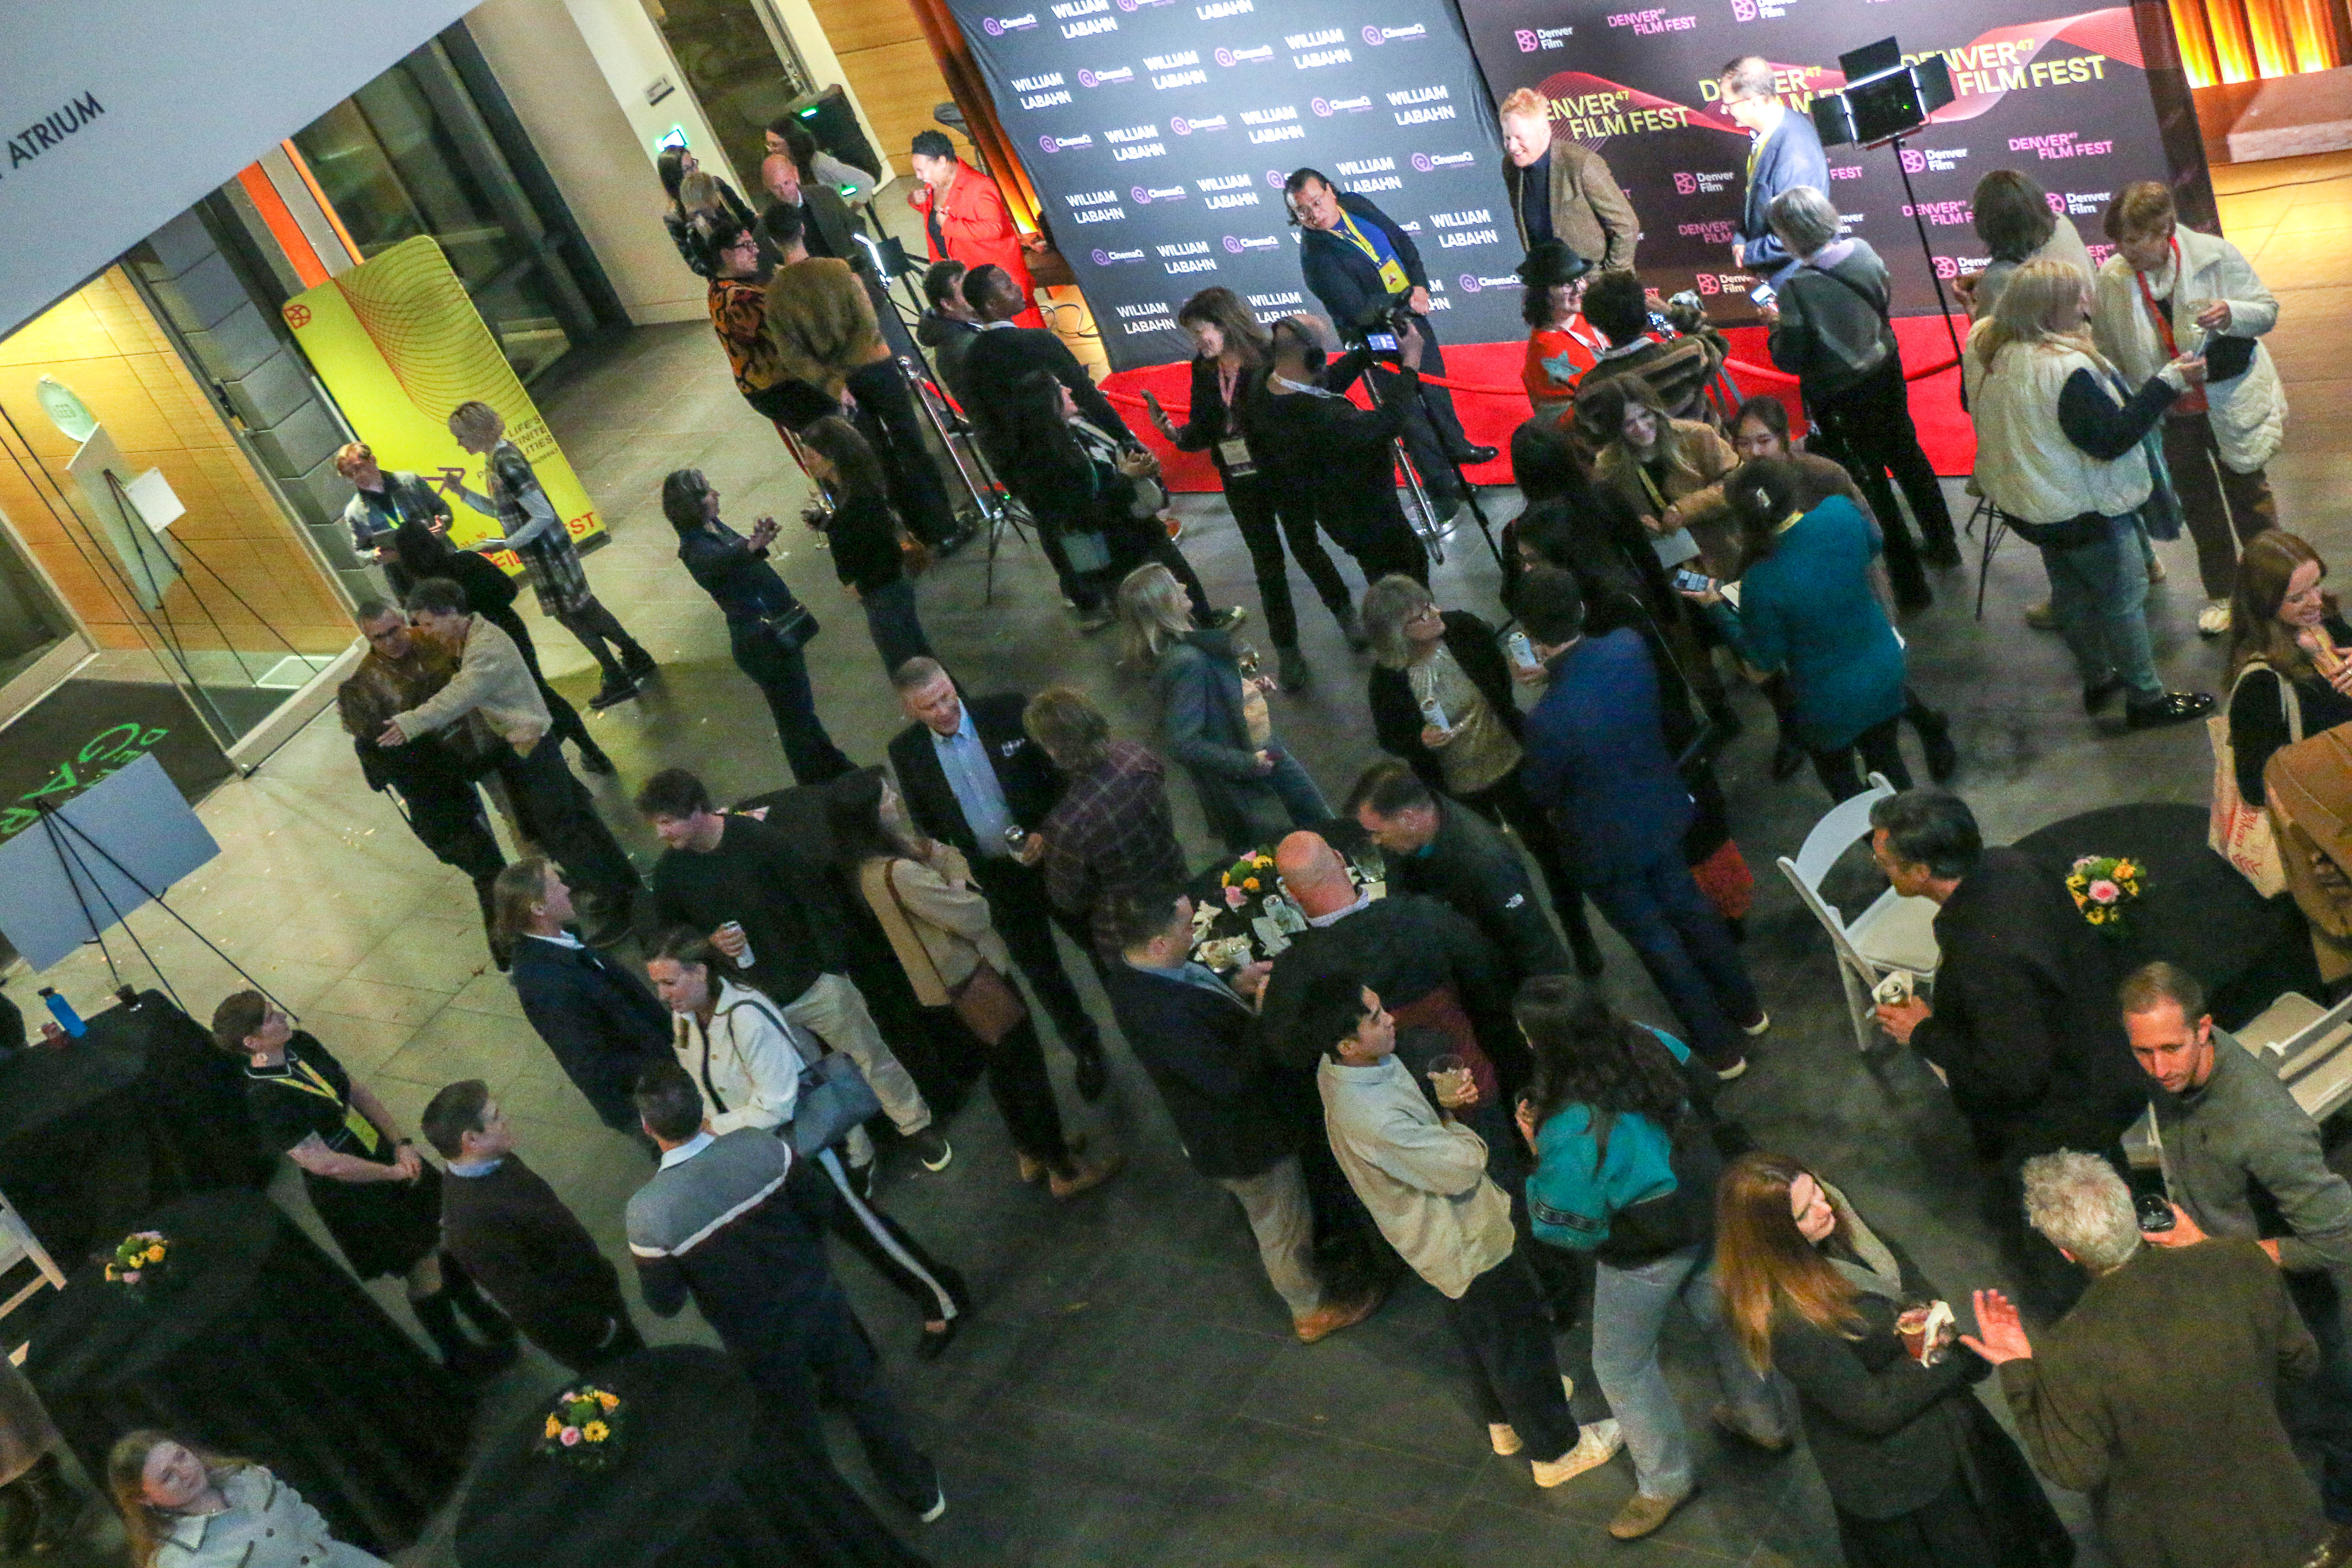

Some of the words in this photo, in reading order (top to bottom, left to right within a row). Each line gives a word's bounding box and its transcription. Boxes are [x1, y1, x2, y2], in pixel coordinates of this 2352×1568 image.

[1050, 0, 1110, 19] WILLIAM
[1196, 0, 1254, 20] LABAHN
[1759, 7, 1785, 19] Film
[999, 14, 1037, 30] CinemaQ
[1060, 16, 1118, 39] LABAHN
[1633, 20, 1665, 36] FILM
[1664, 15, 1697, 31] FEST
[1284, 28, 1345, 50] WILLIAM
[1381, 23, 1426, 39] CinemaQ
[1536, 26, 1573, 40] Denver
[1540, 38, 1564, 50] Film
[1143, 50, 1199, 72] WILLIAM
[1232, 46, 1274, 61] CinemaQ
[1292, 49, 1353, 70] LABAHN
[1011, 72, 1065, 93] WILLIAM
[1094, 67, 1133, 82] CinemaQ
[1152, 70, 1207, 91] LABAHN
[1956, 65, 2028, 96] FILM
[2030, 55, 2106, 88] FEST
[1020, 91, 1072, 110] LABAHN
[1329, 96, 1372, 111] CinemaQ
[1386, 85, 1449, 107] WILLIAM
[1187, 115, 1228, 129] CinemaQ
[1240, 106, 1298, 126] WILLIAM
[1394, 105, 1456, 127] LABAHN
[1568, 111, 1628, 140] FILM
[1629, 106, 1690, 133] FEST
[8, 90, 105, 169] ATRIUM
[1104, 125, 1159, 144] WILLIAM
[1248, 125, 1305, 145] LABAHN
[1055, 134, 1092, 148] CinemaQ
[1112, 143, 1166, 162] LABAHN
[1430, 151, 1474, 166] CinemaQ
[1924, 147, 1968, 162] Denver
[2039, 143, 2074, 160] FILM
[2075, 140, 2113, 157] FEST
[1336, 156, 1396, 177] WILLIAM
[1829, 166, 1863, 180] FEST
[1928, 159, 1955, 172] Film
[1196, 173, 1252, 193] WILLIAM
[1696, 171, 1734, 183] Denver
[1147, 185, 1186, 199] CinemaQ
[1700, 181, 1724, 193] Film
[1065, 190, 1118, 208] WILLIAM
[1204, 192, 1259, 211] LABAHN
[2065, 192, 2111, 205] Denver
[1073, 207, 1126, 225] LABAHN
[2068, 203, 2097, 215] Film
[1430, 209, 1491, 228] WILLIAM
[1929, 212, 1964, 226] FILM
[1239, 235, 1279, 249] CinemaQ
[1439, 230, 1498, 248] LABAHN
[1108, 248, 1145, 261] CinemaQ
[1156, 241, 1210, 258] WILLIAM
[1164, 258, 1218, 275] LABAHN
[1478, 274, 1521, 287] CinemaQ
[1722, 284, 1746, 294] Film
[1246, 291, 1303, 307] WILLIAM
[1116, 302, 1170, 318] WILLIAM
[1123, 318, 1177, 335] LABAHN
